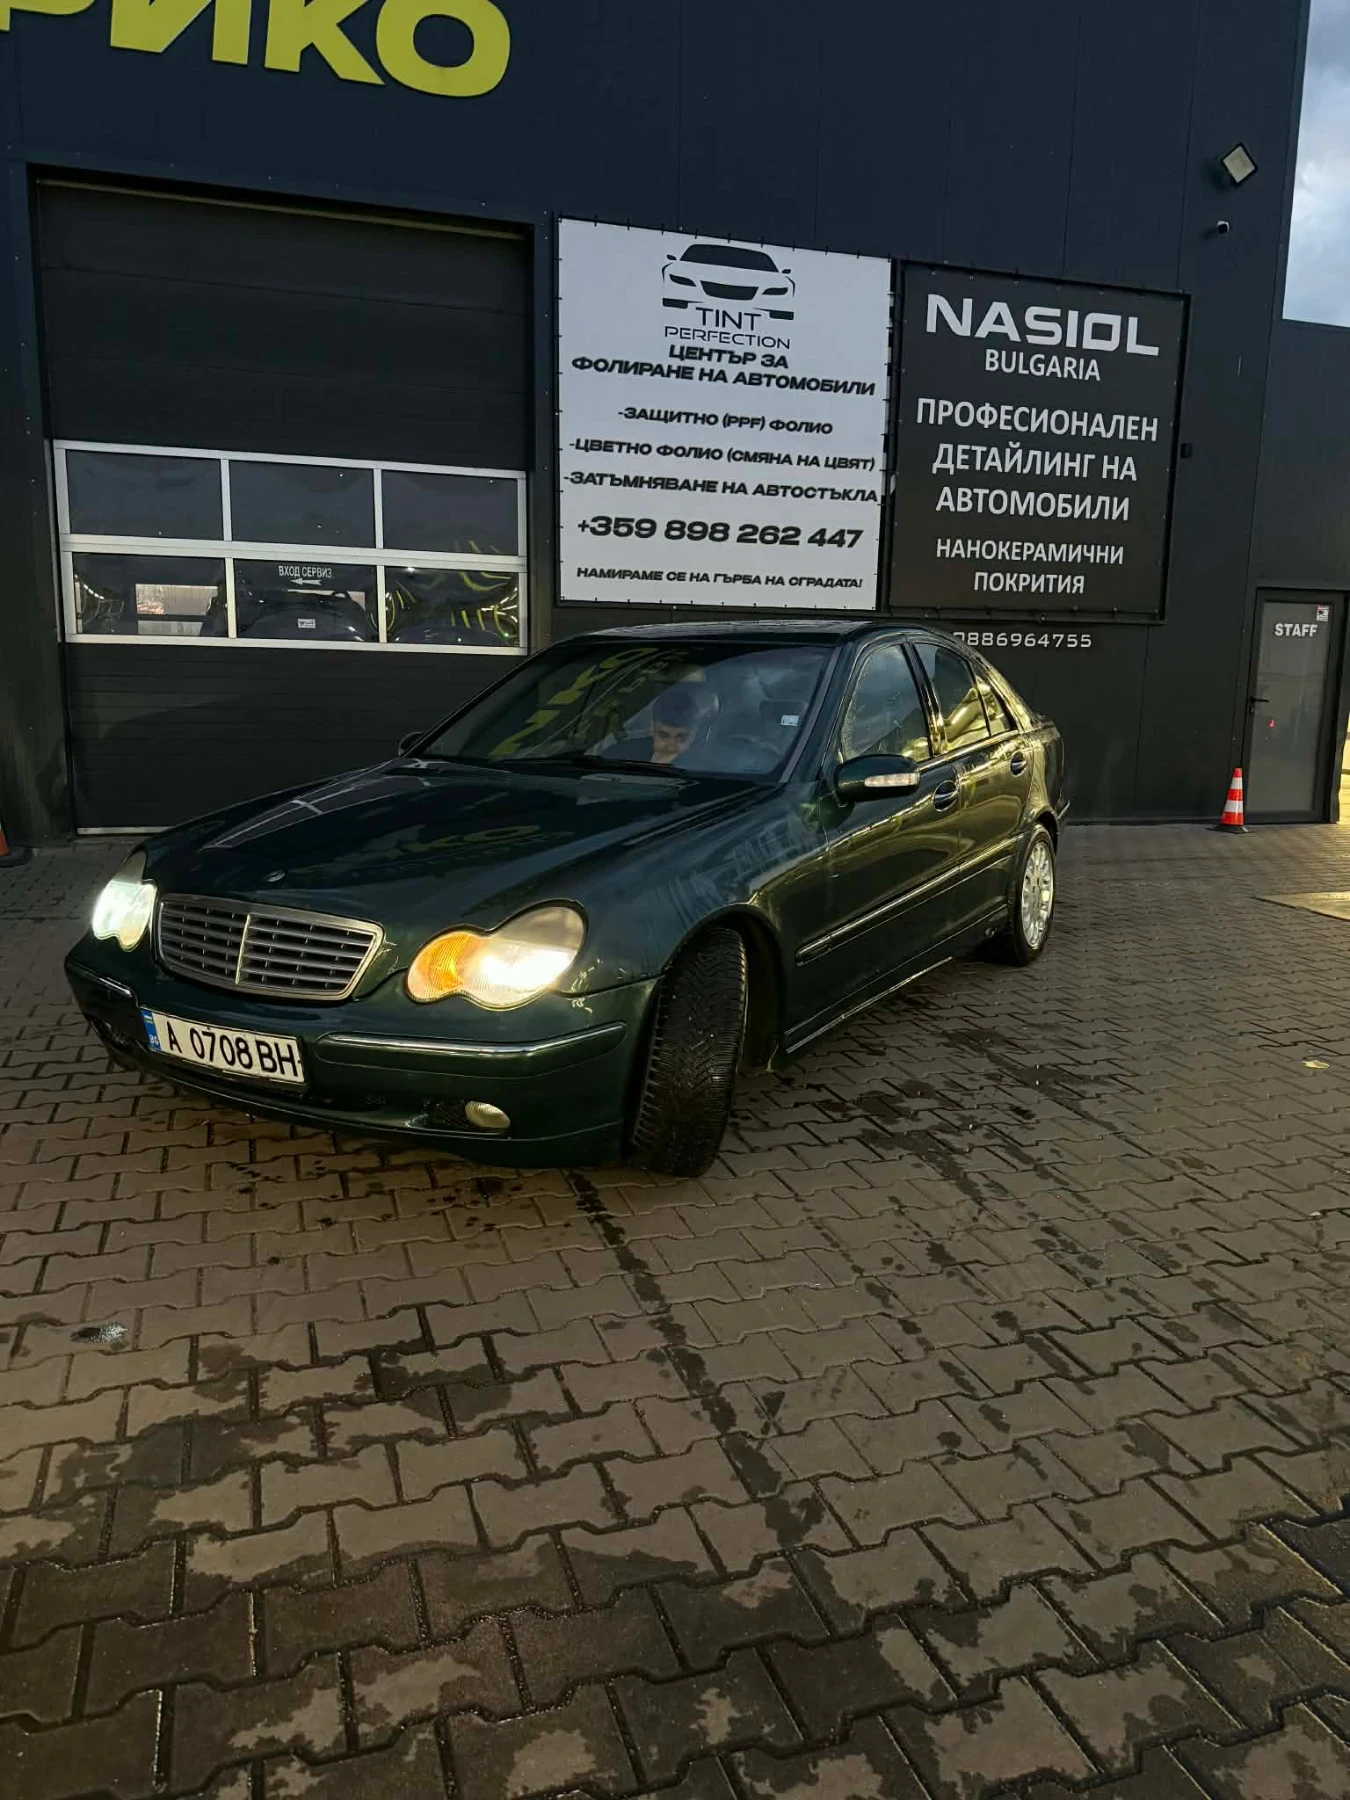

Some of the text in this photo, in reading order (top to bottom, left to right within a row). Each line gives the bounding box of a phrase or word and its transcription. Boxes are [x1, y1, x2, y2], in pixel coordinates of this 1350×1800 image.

[0, 0, 510, 96] ИКО
[695, 307, 762, 331] TINT
[926, 293, 1159, 356] NASIOL
[664, 326, 790, 349] PERFECTION
[668, 344, 789, 369] ЦЕНТЪР ЗА
[985, 349, 1101, 381] BULGARIA
[571, 356, 876, 396] ФОЛИРАНЕ НА АВТОМОБИЛИ
[618, 407, 833, 435] -ЗАЩИТНО (PPF) ФОЛИО
[916, 397, 1158, 441] ПРОФЕСИОНАЛЕН
[569, 438, 875, 472] -ЦВЕТНО ФОЛИО (СМЯНА НА ЦВЯТ)
[932, 441, 1138, 481] ДЕТАЙЛИНГ НА
[563, 471, 878, 502] -ЗАТЪМНЯВАНЕ НА АВТОСТЪКЛА
[935, 486, 1130, 521] АВТОМОБИЛИ
[577, 515, 864, 548] +359 898 262 447
[936, 538, 1124, 565] НАНОКЕРАМИЧНИ
[278, 565, 332, 578] ВХОД СЕРВИЗ
[576, 567, 863, 589] НАМИРАМЕ СЕ НА ГЪРБА НА СГРАДАТА!
[974, 572, 1085, 594] ПОКРИТИЯ
[1274, 622, 1318, 637] STAFF
[189, 1027, 254, 1069] 0708
